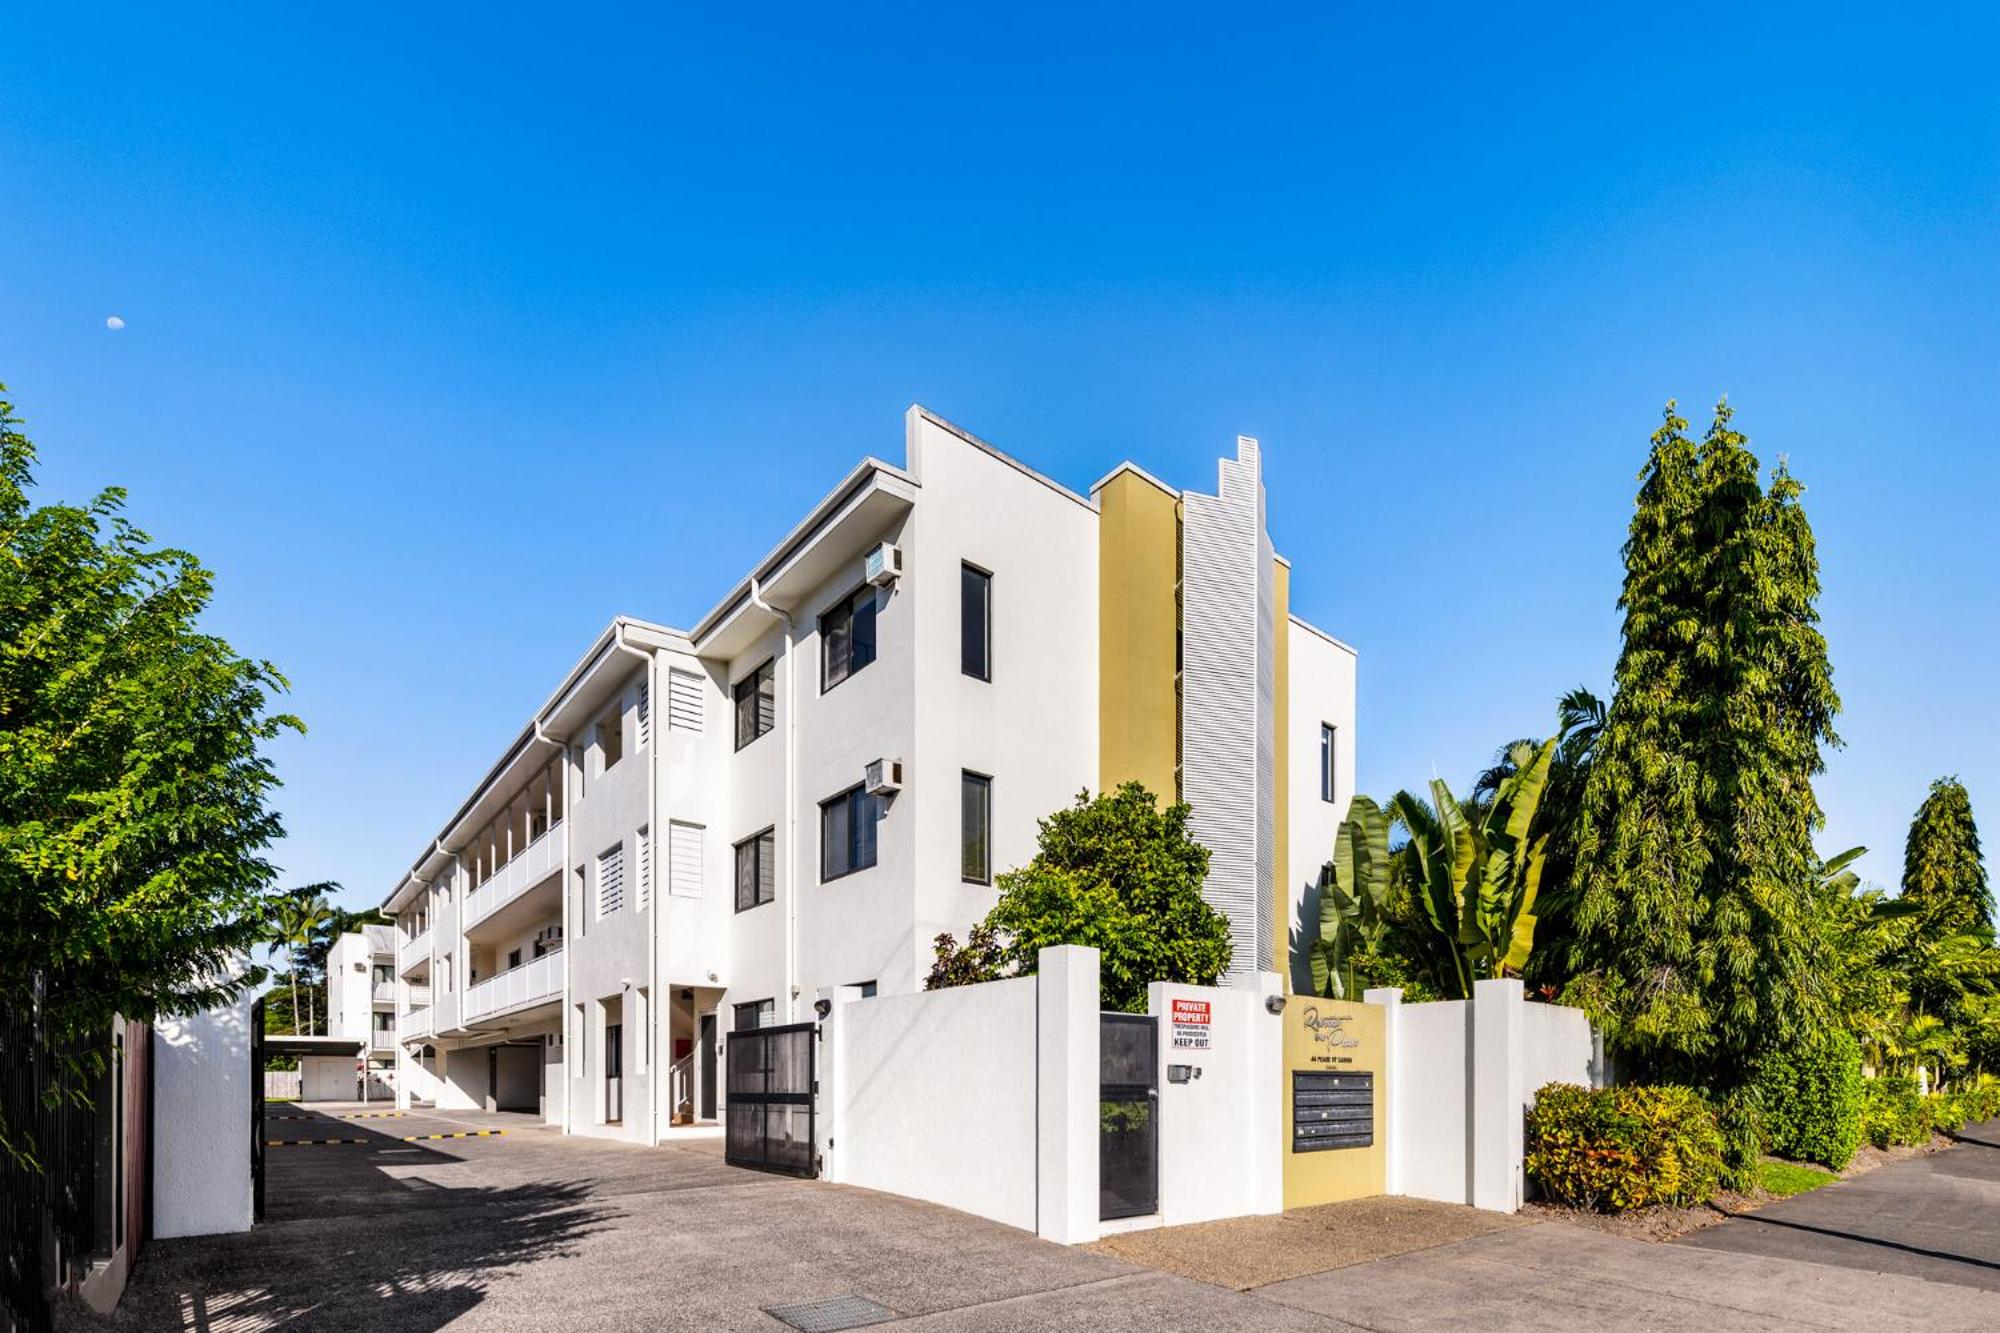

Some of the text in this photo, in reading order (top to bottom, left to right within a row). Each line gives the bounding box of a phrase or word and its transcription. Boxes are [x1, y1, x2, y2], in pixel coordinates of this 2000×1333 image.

[1176, 1001, 1206, 1012] PRIVATE
[1173, 1011, 1209, 1023] PROPERTY
[1174, 1038, 1208, 1047] KEEP OUT
